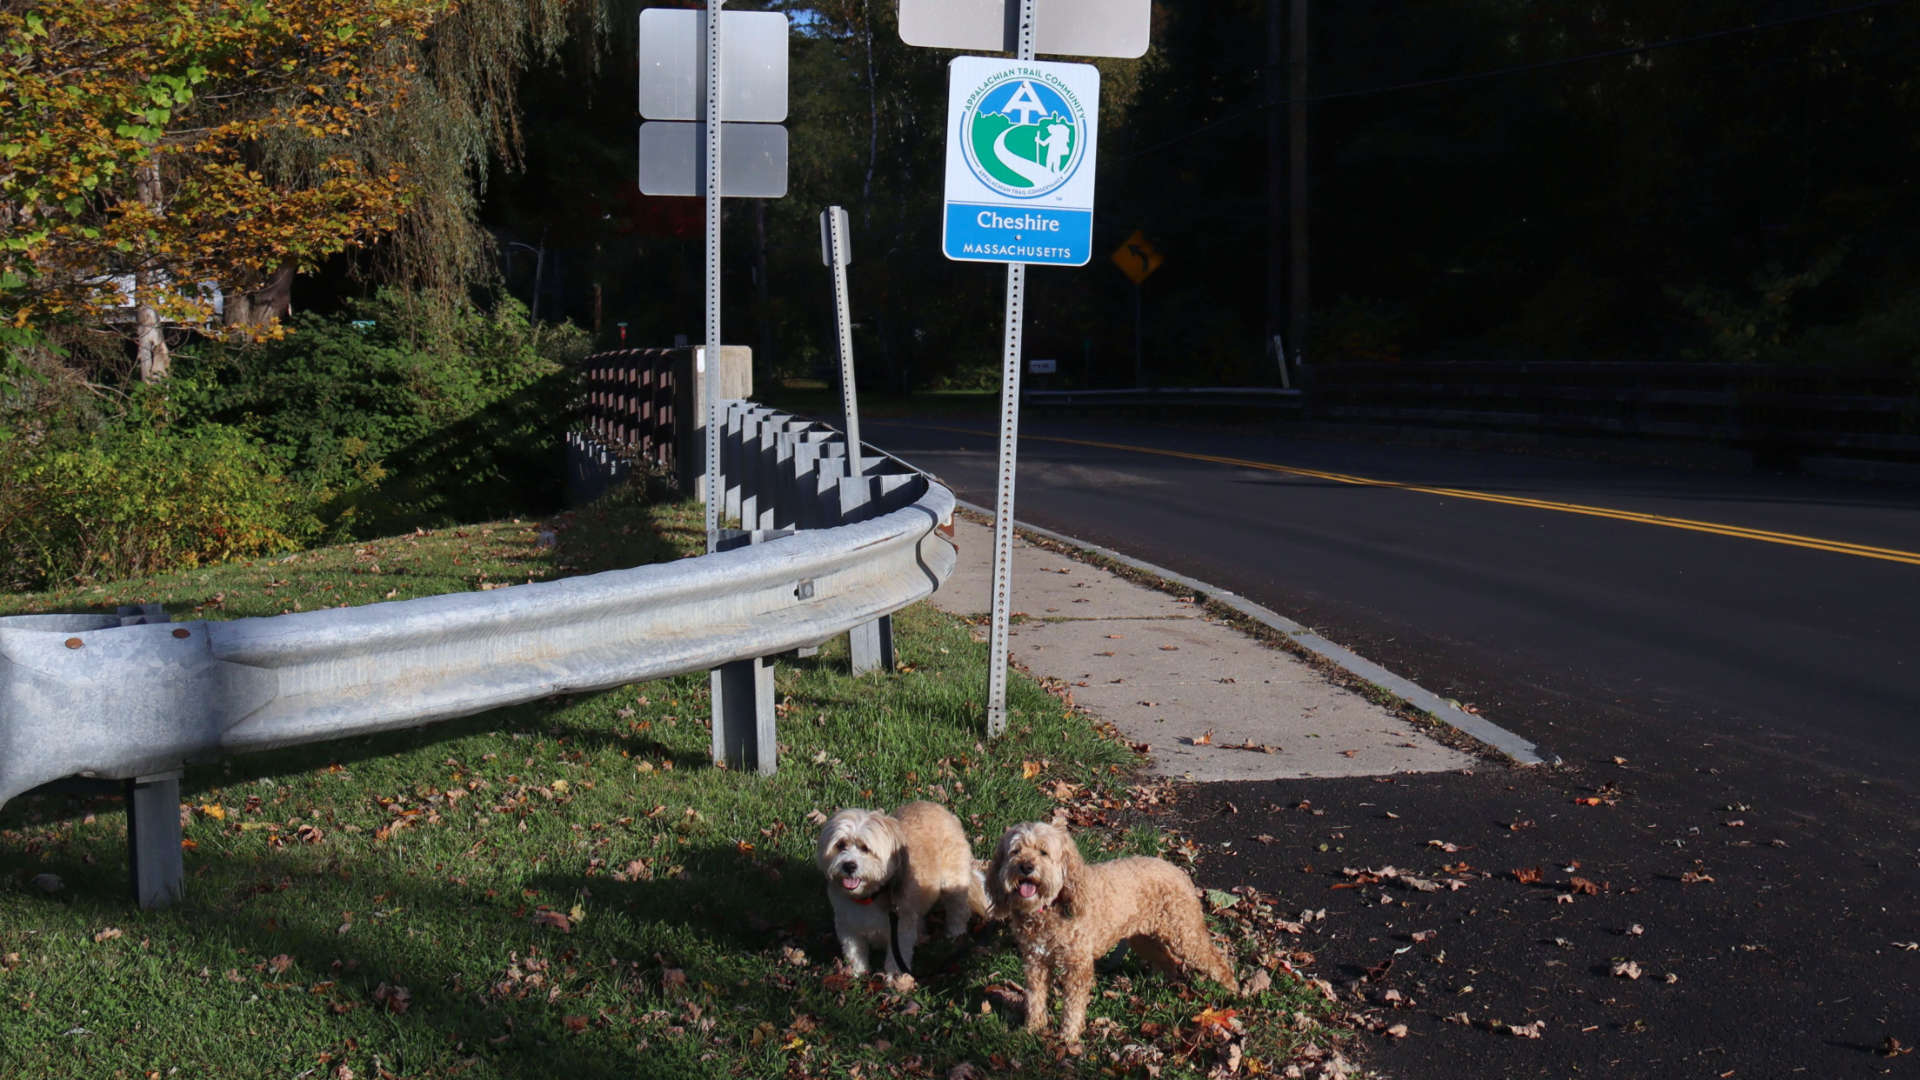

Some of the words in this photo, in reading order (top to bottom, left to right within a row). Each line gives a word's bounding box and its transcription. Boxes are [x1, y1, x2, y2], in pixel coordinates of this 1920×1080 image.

[965, 68, 1015, 111] APPALACHIAN
[1017, 67, 1042, 78] TRAIL
[1044, 73, 1086, 119] COMMUNITY
[977, 211, 1060, 232] Cheshire
[962, 243, 1072, 258] MASSACHUSETTS
